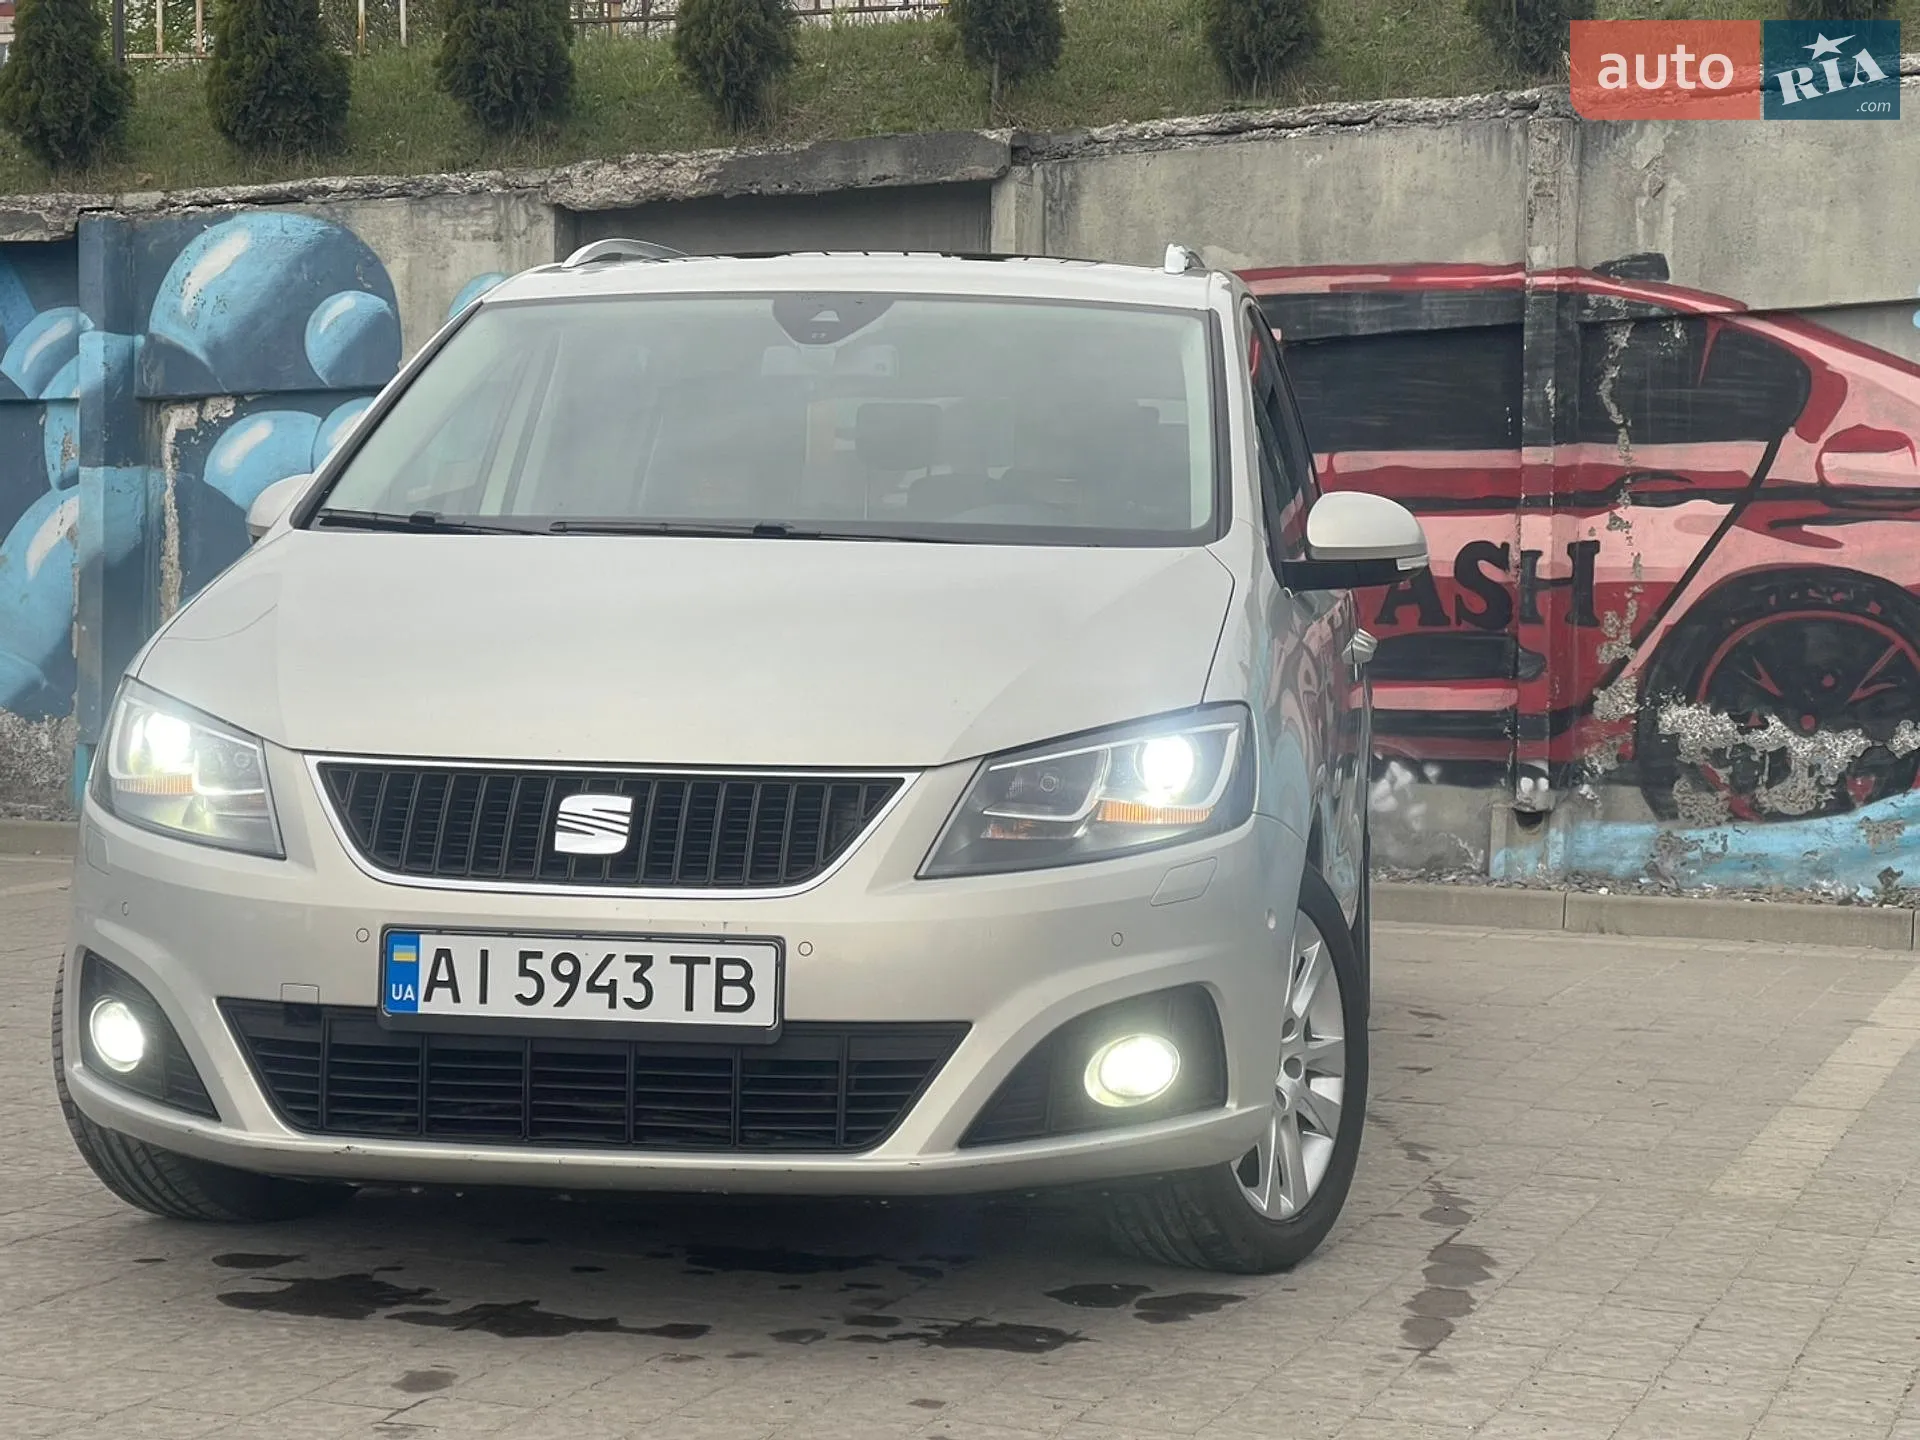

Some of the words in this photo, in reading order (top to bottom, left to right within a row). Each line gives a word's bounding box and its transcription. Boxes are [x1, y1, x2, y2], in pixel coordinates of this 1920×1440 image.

[391, 983, 416, 1001] UA
[423, 948, 489, 1005] AI
[514, 950, 654, 1010] 5943
[670, 955, 756, 1013] TB
